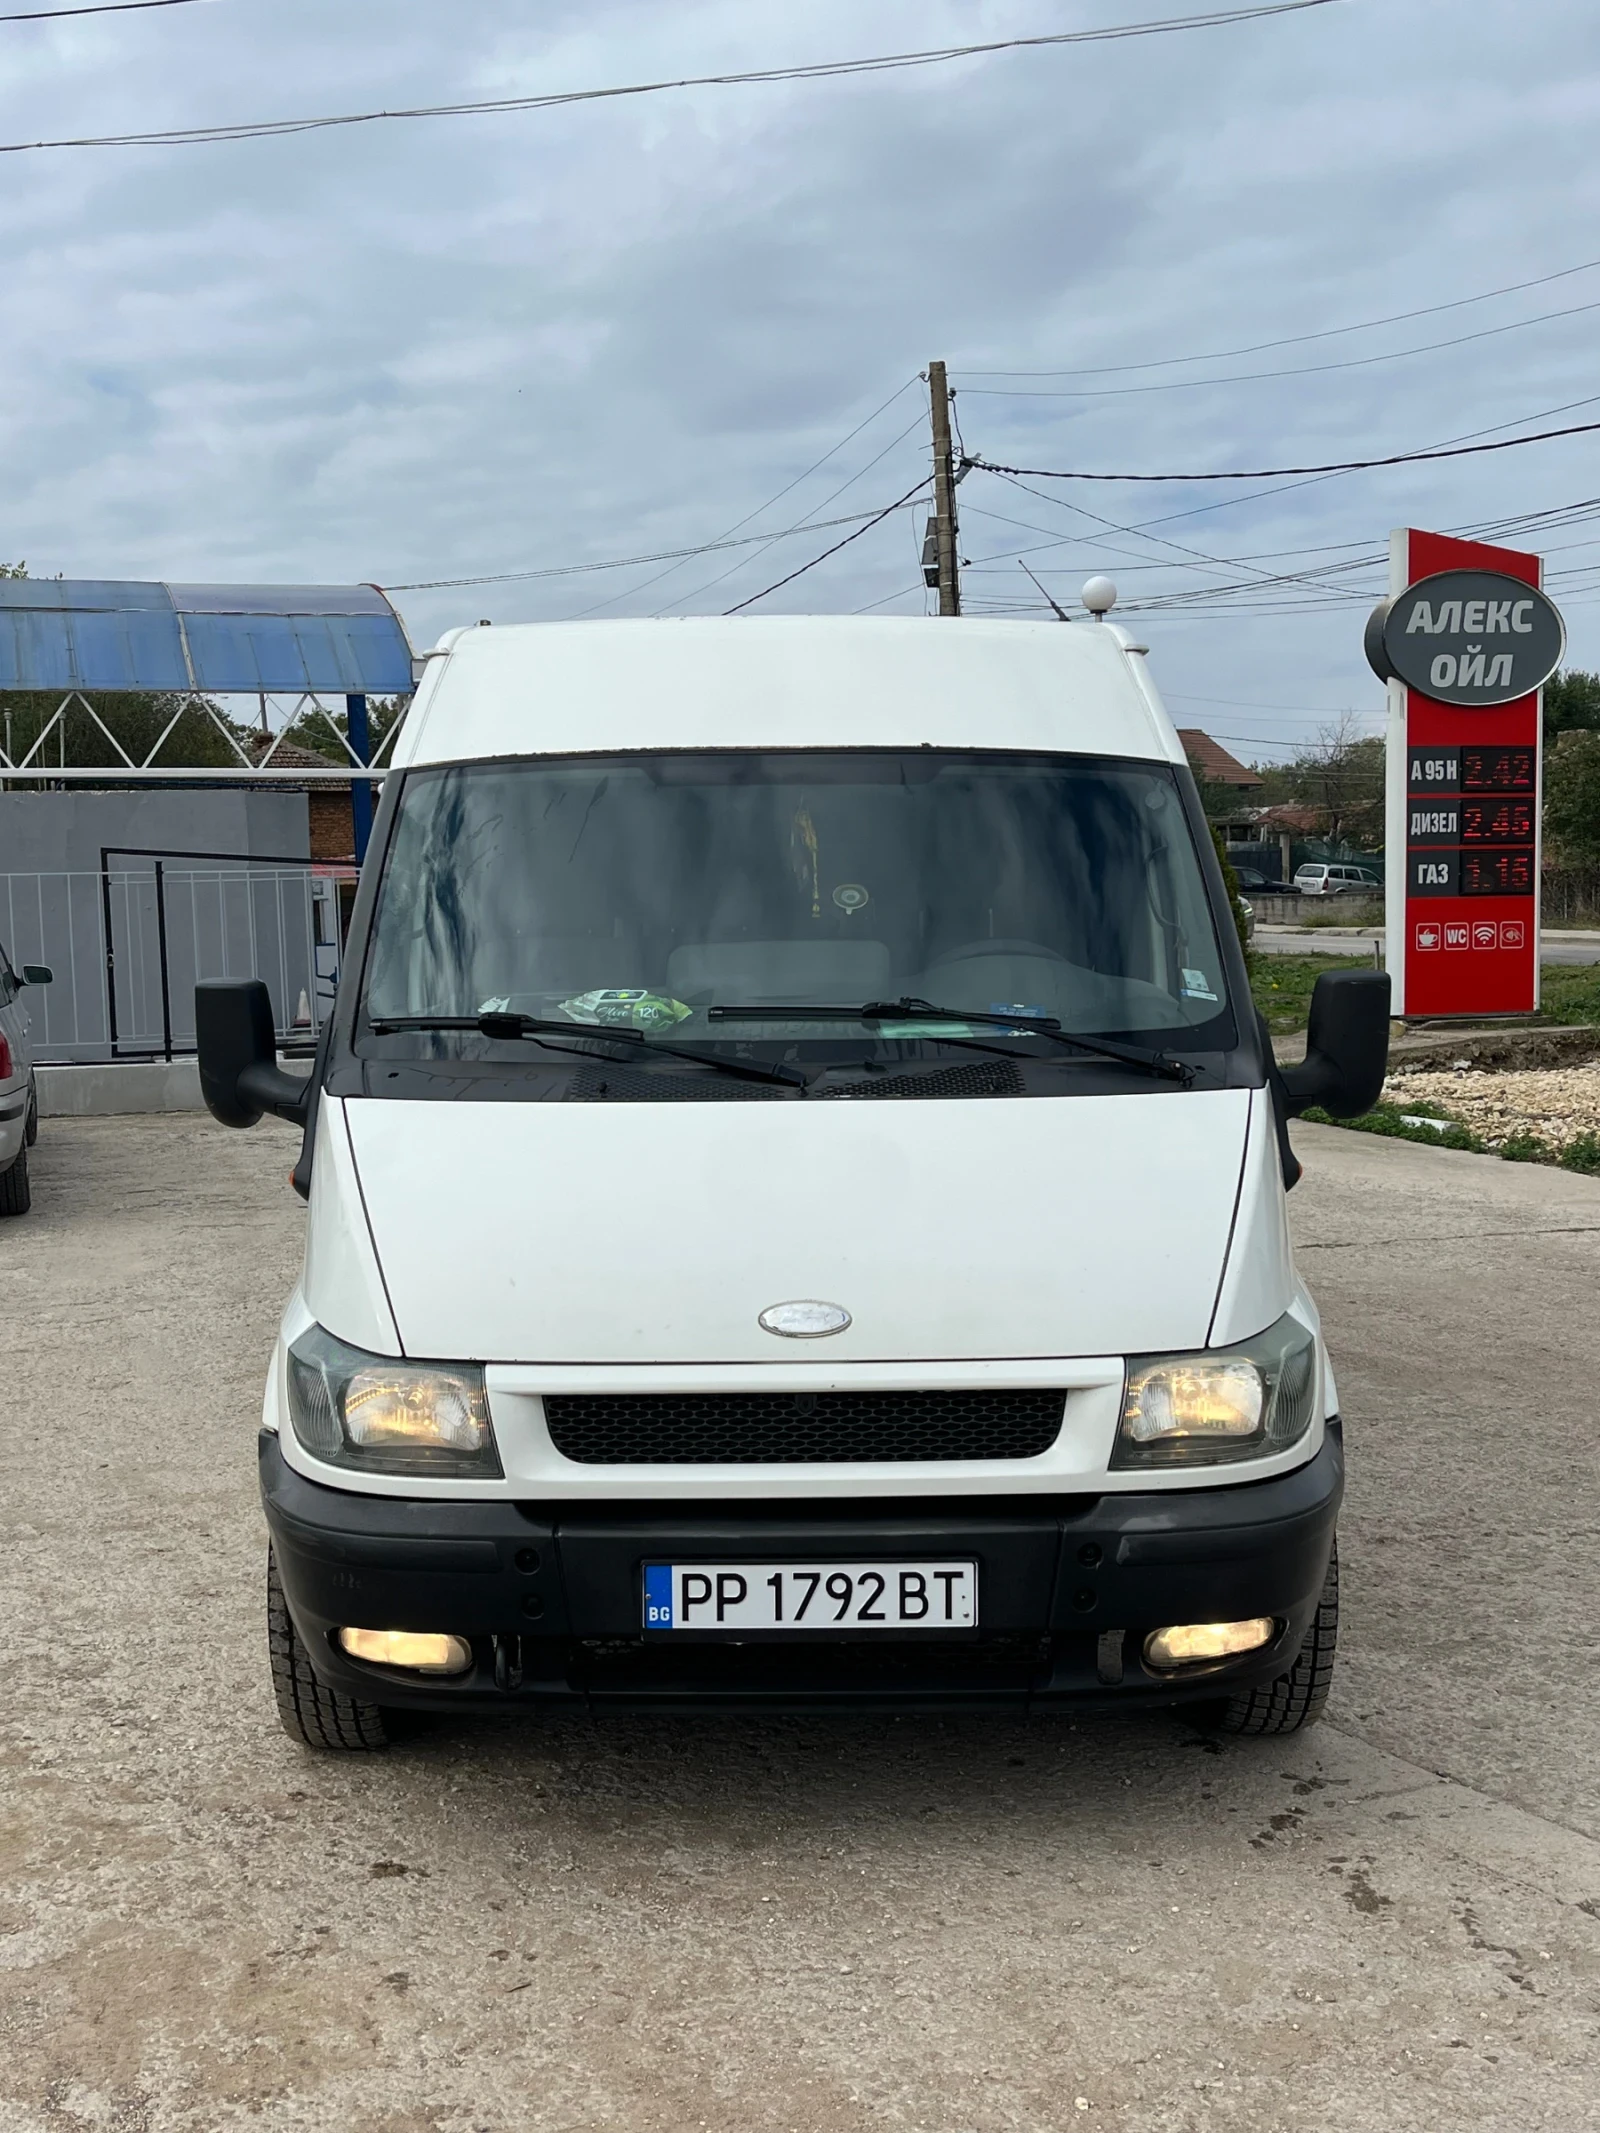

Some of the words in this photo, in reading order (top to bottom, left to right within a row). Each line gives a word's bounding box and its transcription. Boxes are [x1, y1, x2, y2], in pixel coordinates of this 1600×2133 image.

[1405, 600, 1534, 634] АЛЕКС
[1430, 644, 1514, 688] ОЙЛ
[1464, 755, 1530, 785] 2.42
[1410, 812, 1457, 836] ДИЗЕЛ
[1417, 863, 1449, 884] ГАЗ
[1466, 857, 1529, 887] 1.15
[1446, 928, 1467, 944] WC
[648, 1606, 670, 1622] BG
